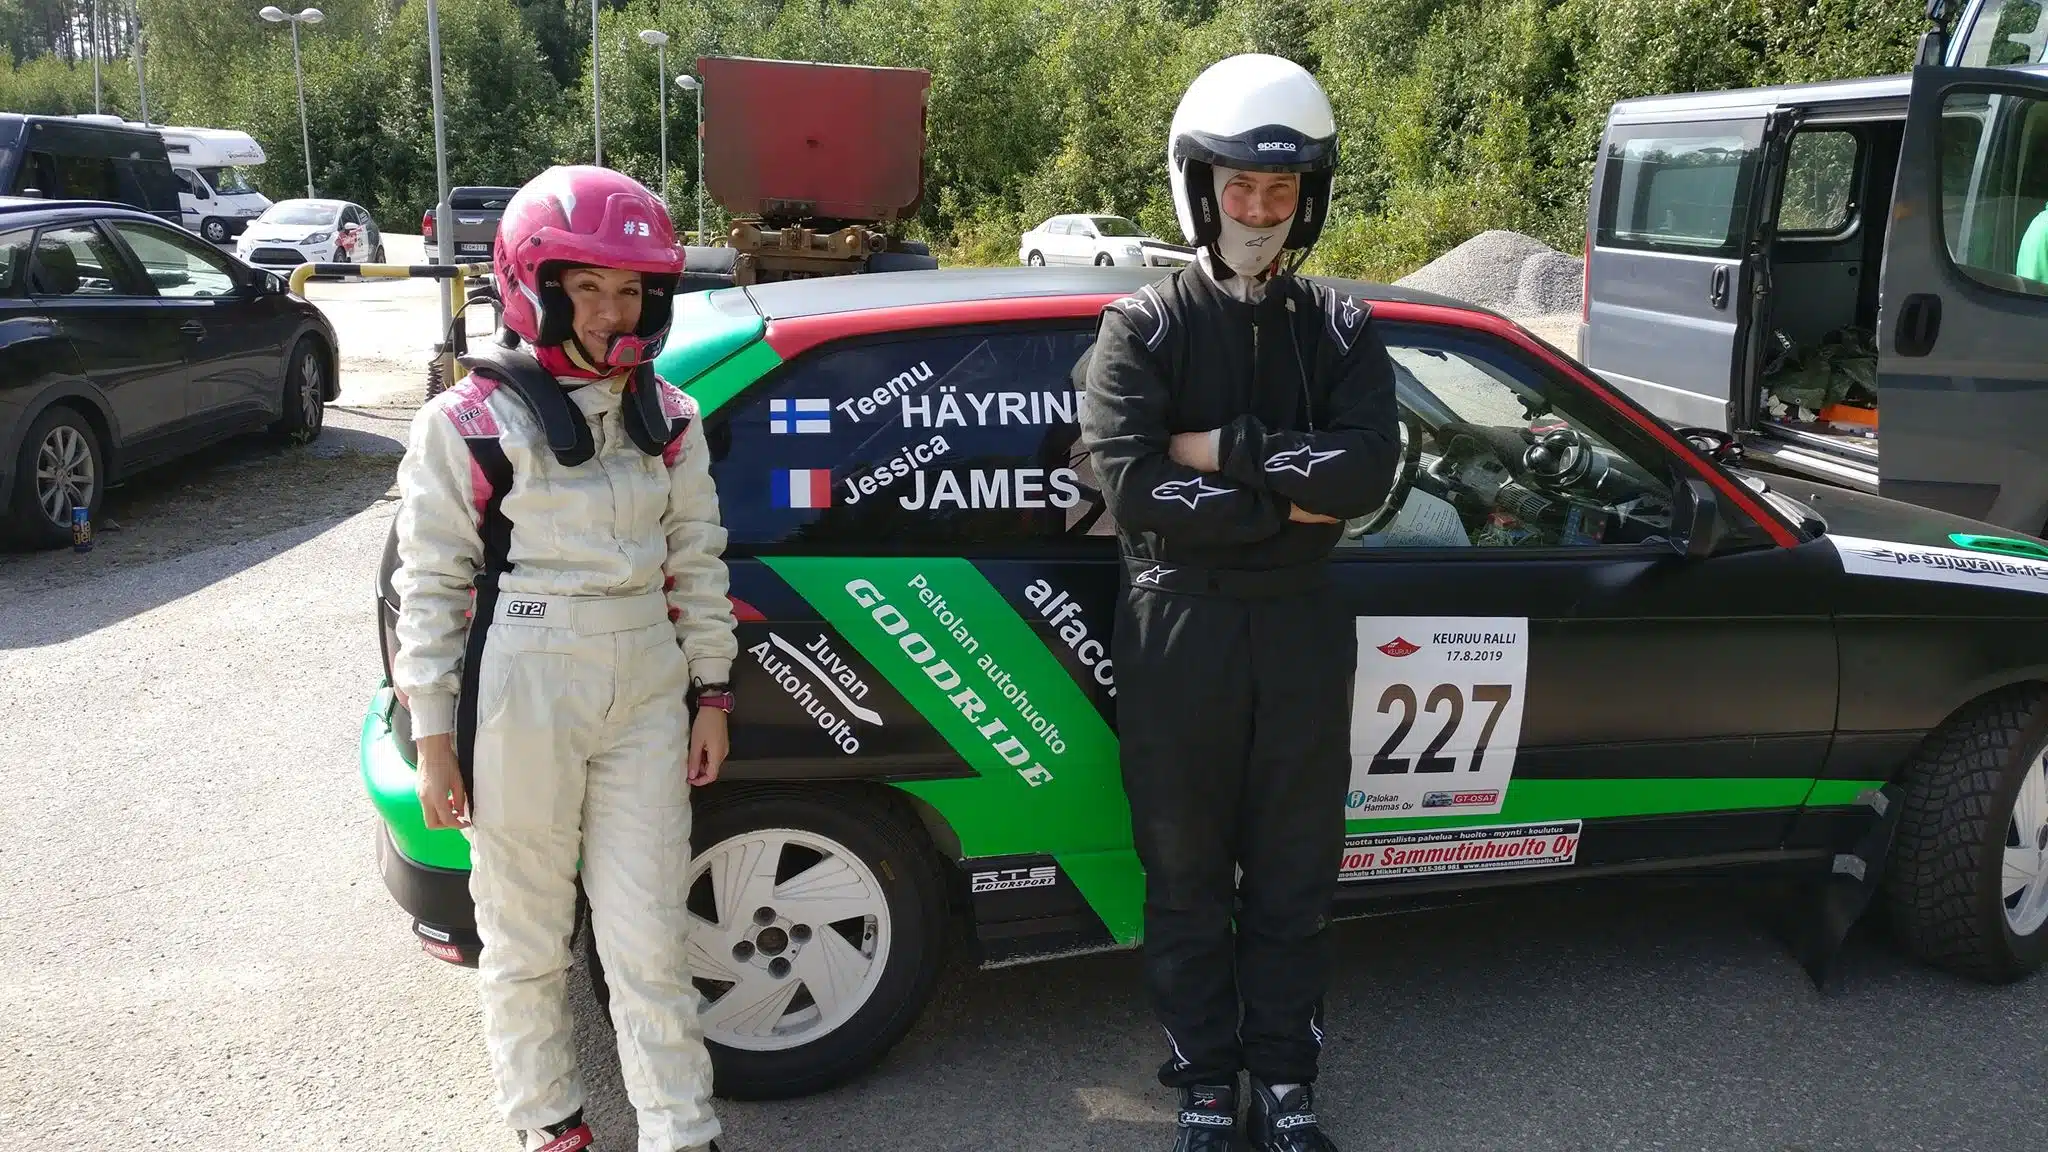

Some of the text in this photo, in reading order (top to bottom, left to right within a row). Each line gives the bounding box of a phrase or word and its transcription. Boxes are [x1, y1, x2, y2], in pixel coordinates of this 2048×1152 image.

[1257, 141, 1296, 150] sparco
[835, 361, 934, 424] Teemu
[843, 434, 951, 506] Jessica
[899, 468, 1081, 510] JAMES
[508, 601, 547, 616] GT2i
[1432, 633, 1516, 644] KEURUU RALLI
[805, 633, 869, 700] Juvan
[907, 573, 1067, 755] Peltolan autohuolto
[1447, 651, 1503, 661] 17.8.2019
[845, 578, 1054, 788] GOODRIDE
[748, 640, 860, 755] Autohuolto
[1367, 683, 1512, 775] 227
[1364, 802, 1414, 812] Hammas Oy
[1366, 794, 1399, 802] Palokan
[1455, 794, 1495, 803] GT-OSAT
[1345, 827, 1564, 847] vuotta turvallista palvelua huolto myynti koulutus
[1381, 838, 1546, 867] Sammutinhuolto
[1552, 835, 1578, 856] Oy
[974, 878, 1053, 891] MOTORSPORT
